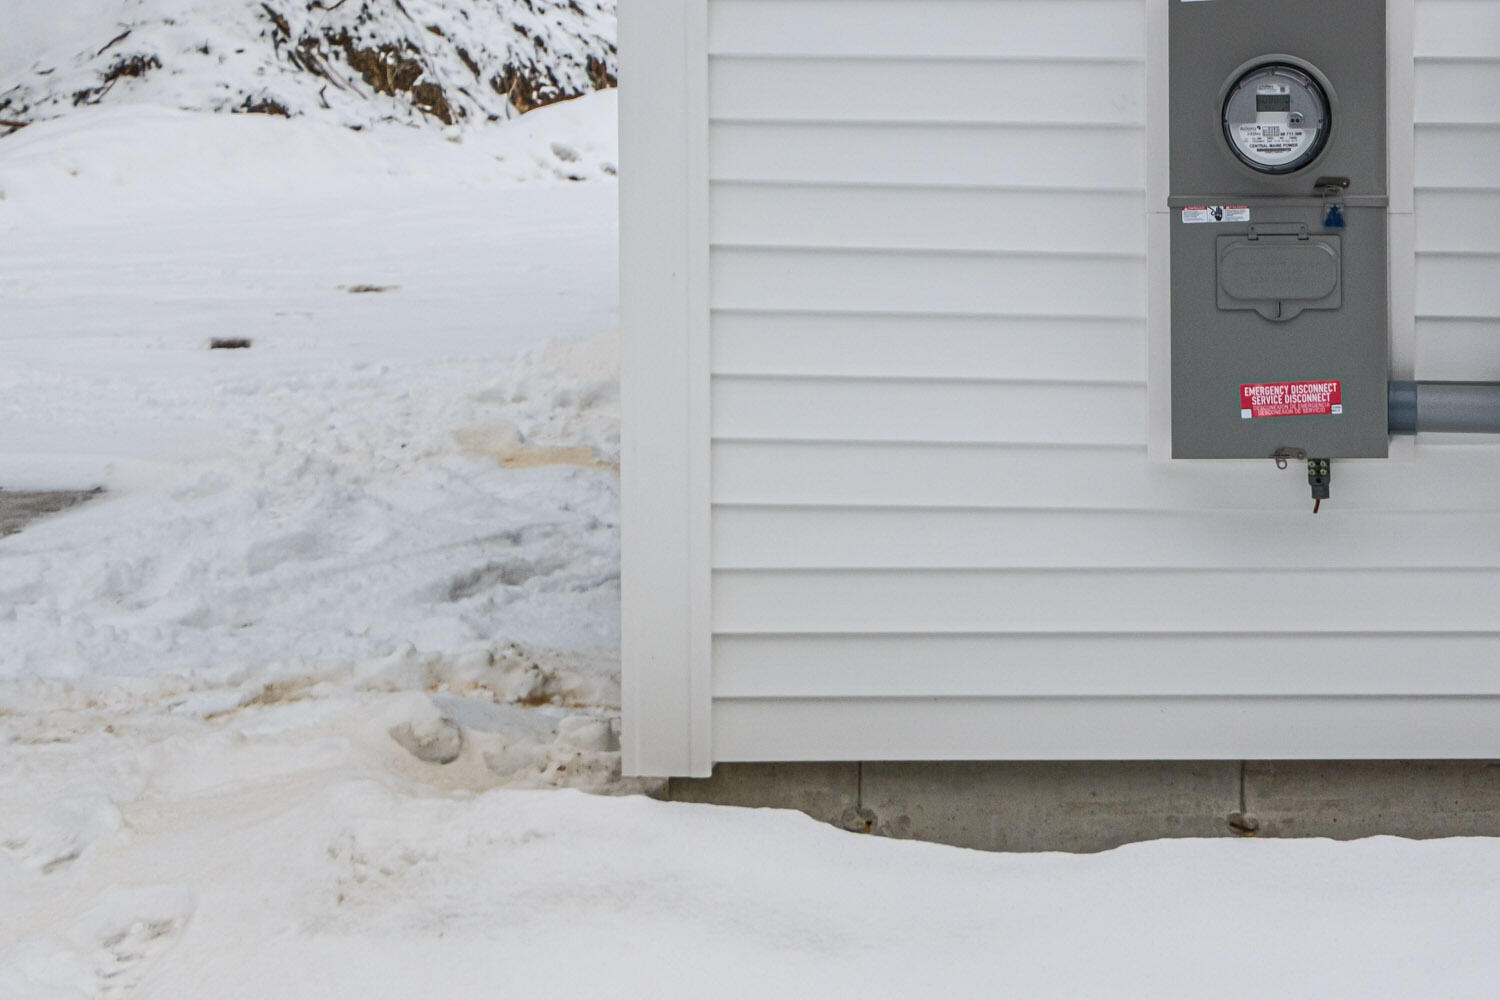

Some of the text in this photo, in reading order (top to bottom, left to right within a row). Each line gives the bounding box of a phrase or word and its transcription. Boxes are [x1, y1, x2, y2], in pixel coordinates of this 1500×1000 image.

[1244, 382, 1337, 397] EMERGENCY DISCONNECT
[1251, 392, 1331, 406] SERVICE DISCONNECT
